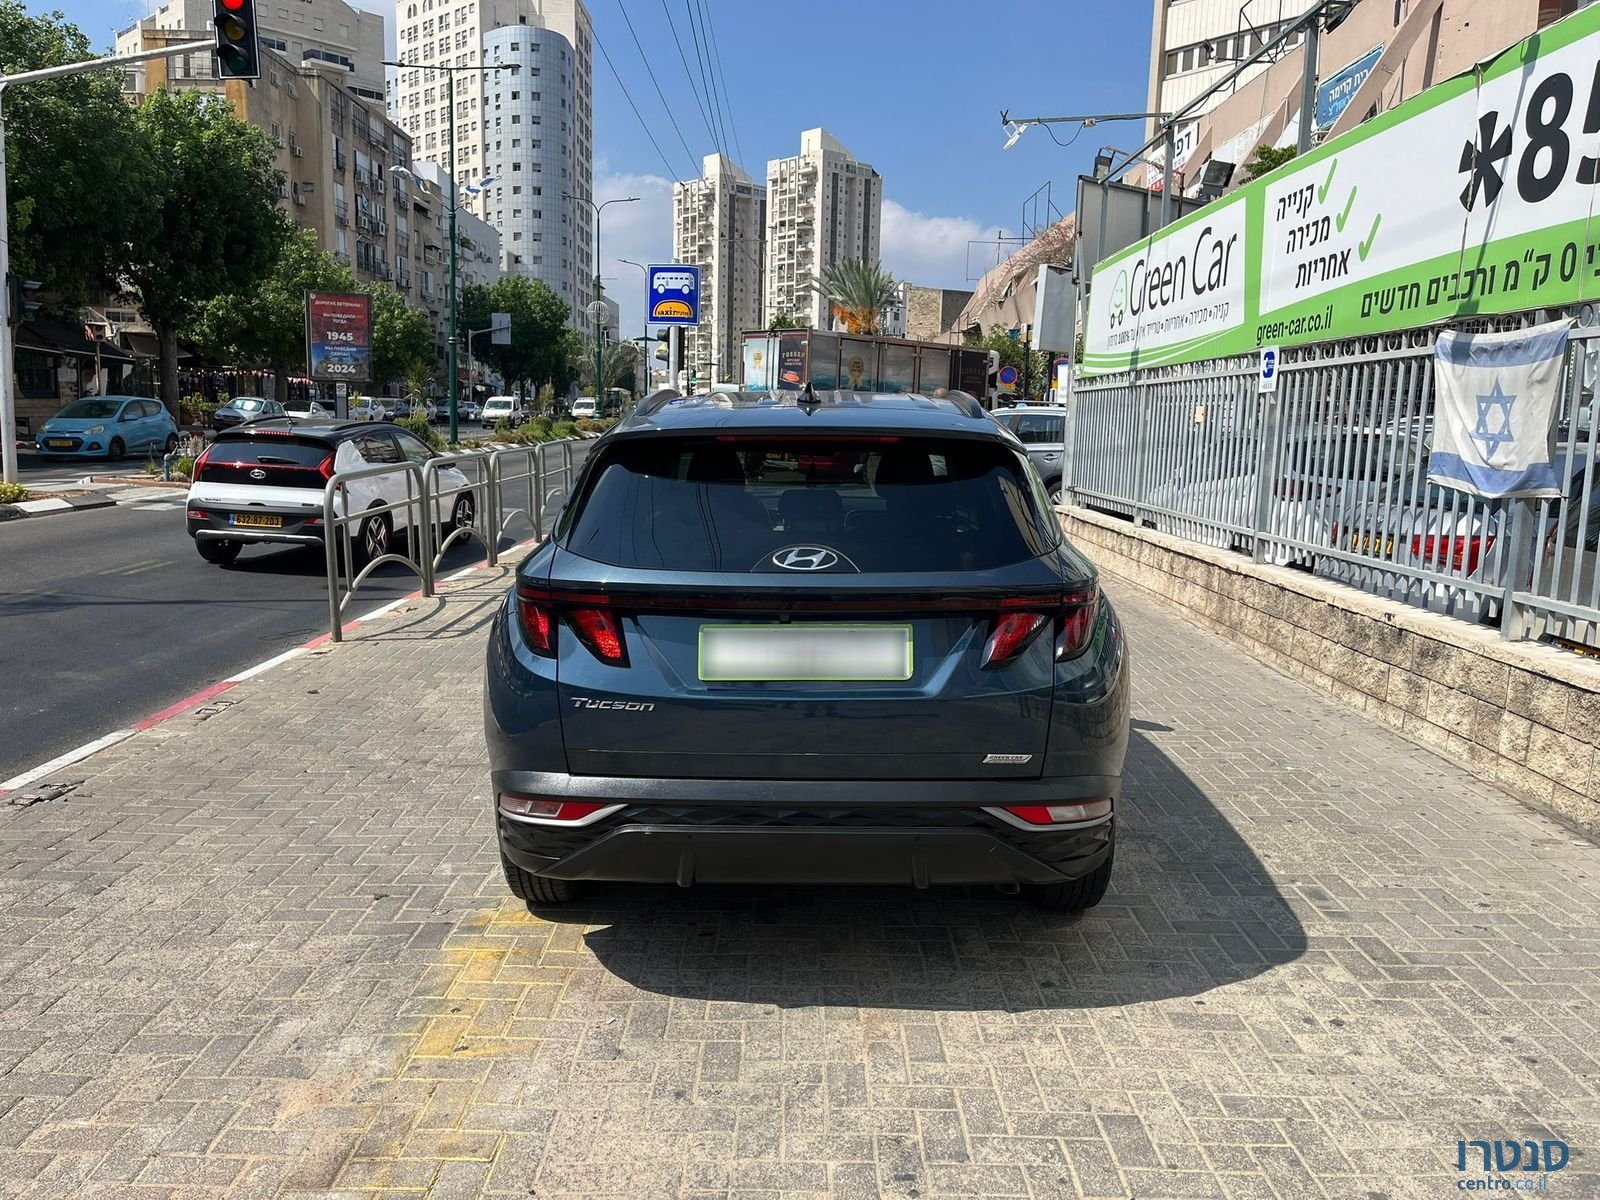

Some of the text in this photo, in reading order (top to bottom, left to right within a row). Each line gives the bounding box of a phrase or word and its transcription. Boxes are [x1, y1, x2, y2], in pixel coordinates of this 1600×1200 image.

[1329, 78, 1352, 102] קדימה
[1276, 183, 1315, 222] קנייה
[1286, 215, 1331, 254] מכירה
[1130, 226, 1238, 316] Green Car
[1295, 248, 1352, 289] אחריות
[1426, 265, 1496, 306] ורכבים
[1361, 282, 1421, 318] חדשים
[326, 331, 354, 341] 1945
[1256, 304, 1333, 346] green-car.co.il
[327, 364, 356, 374] 2024
